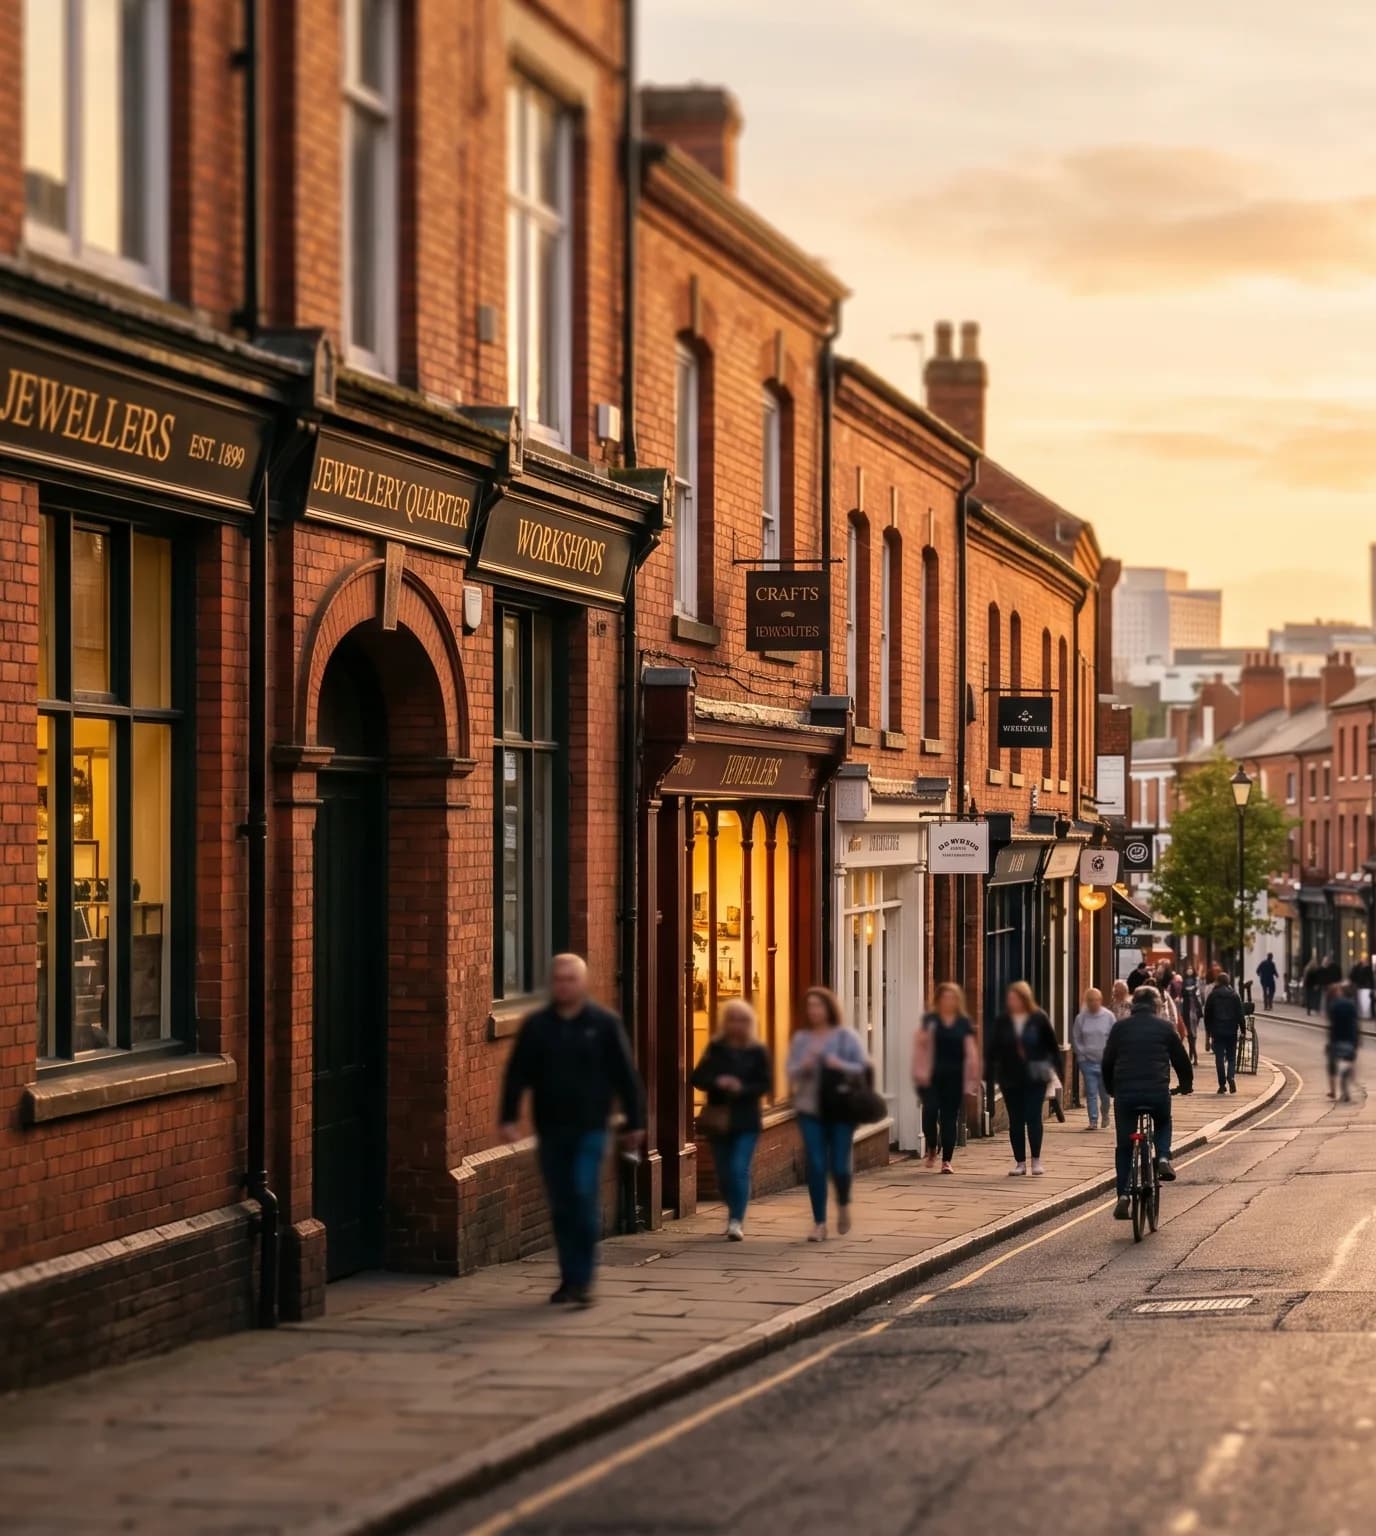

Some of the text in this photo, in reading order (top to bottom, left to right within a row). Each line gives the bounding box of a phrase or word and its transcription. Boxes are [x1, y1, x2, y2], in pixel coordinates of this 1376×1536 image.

[0, 368, 246, 469] JEWELLERS EST. 1899
[313, 456, 470, 529] JEWELLERY QUARTER
[517, 518, 606, 576] WORKSHOPS
[755, 586, 819, 601] CRAFTS
